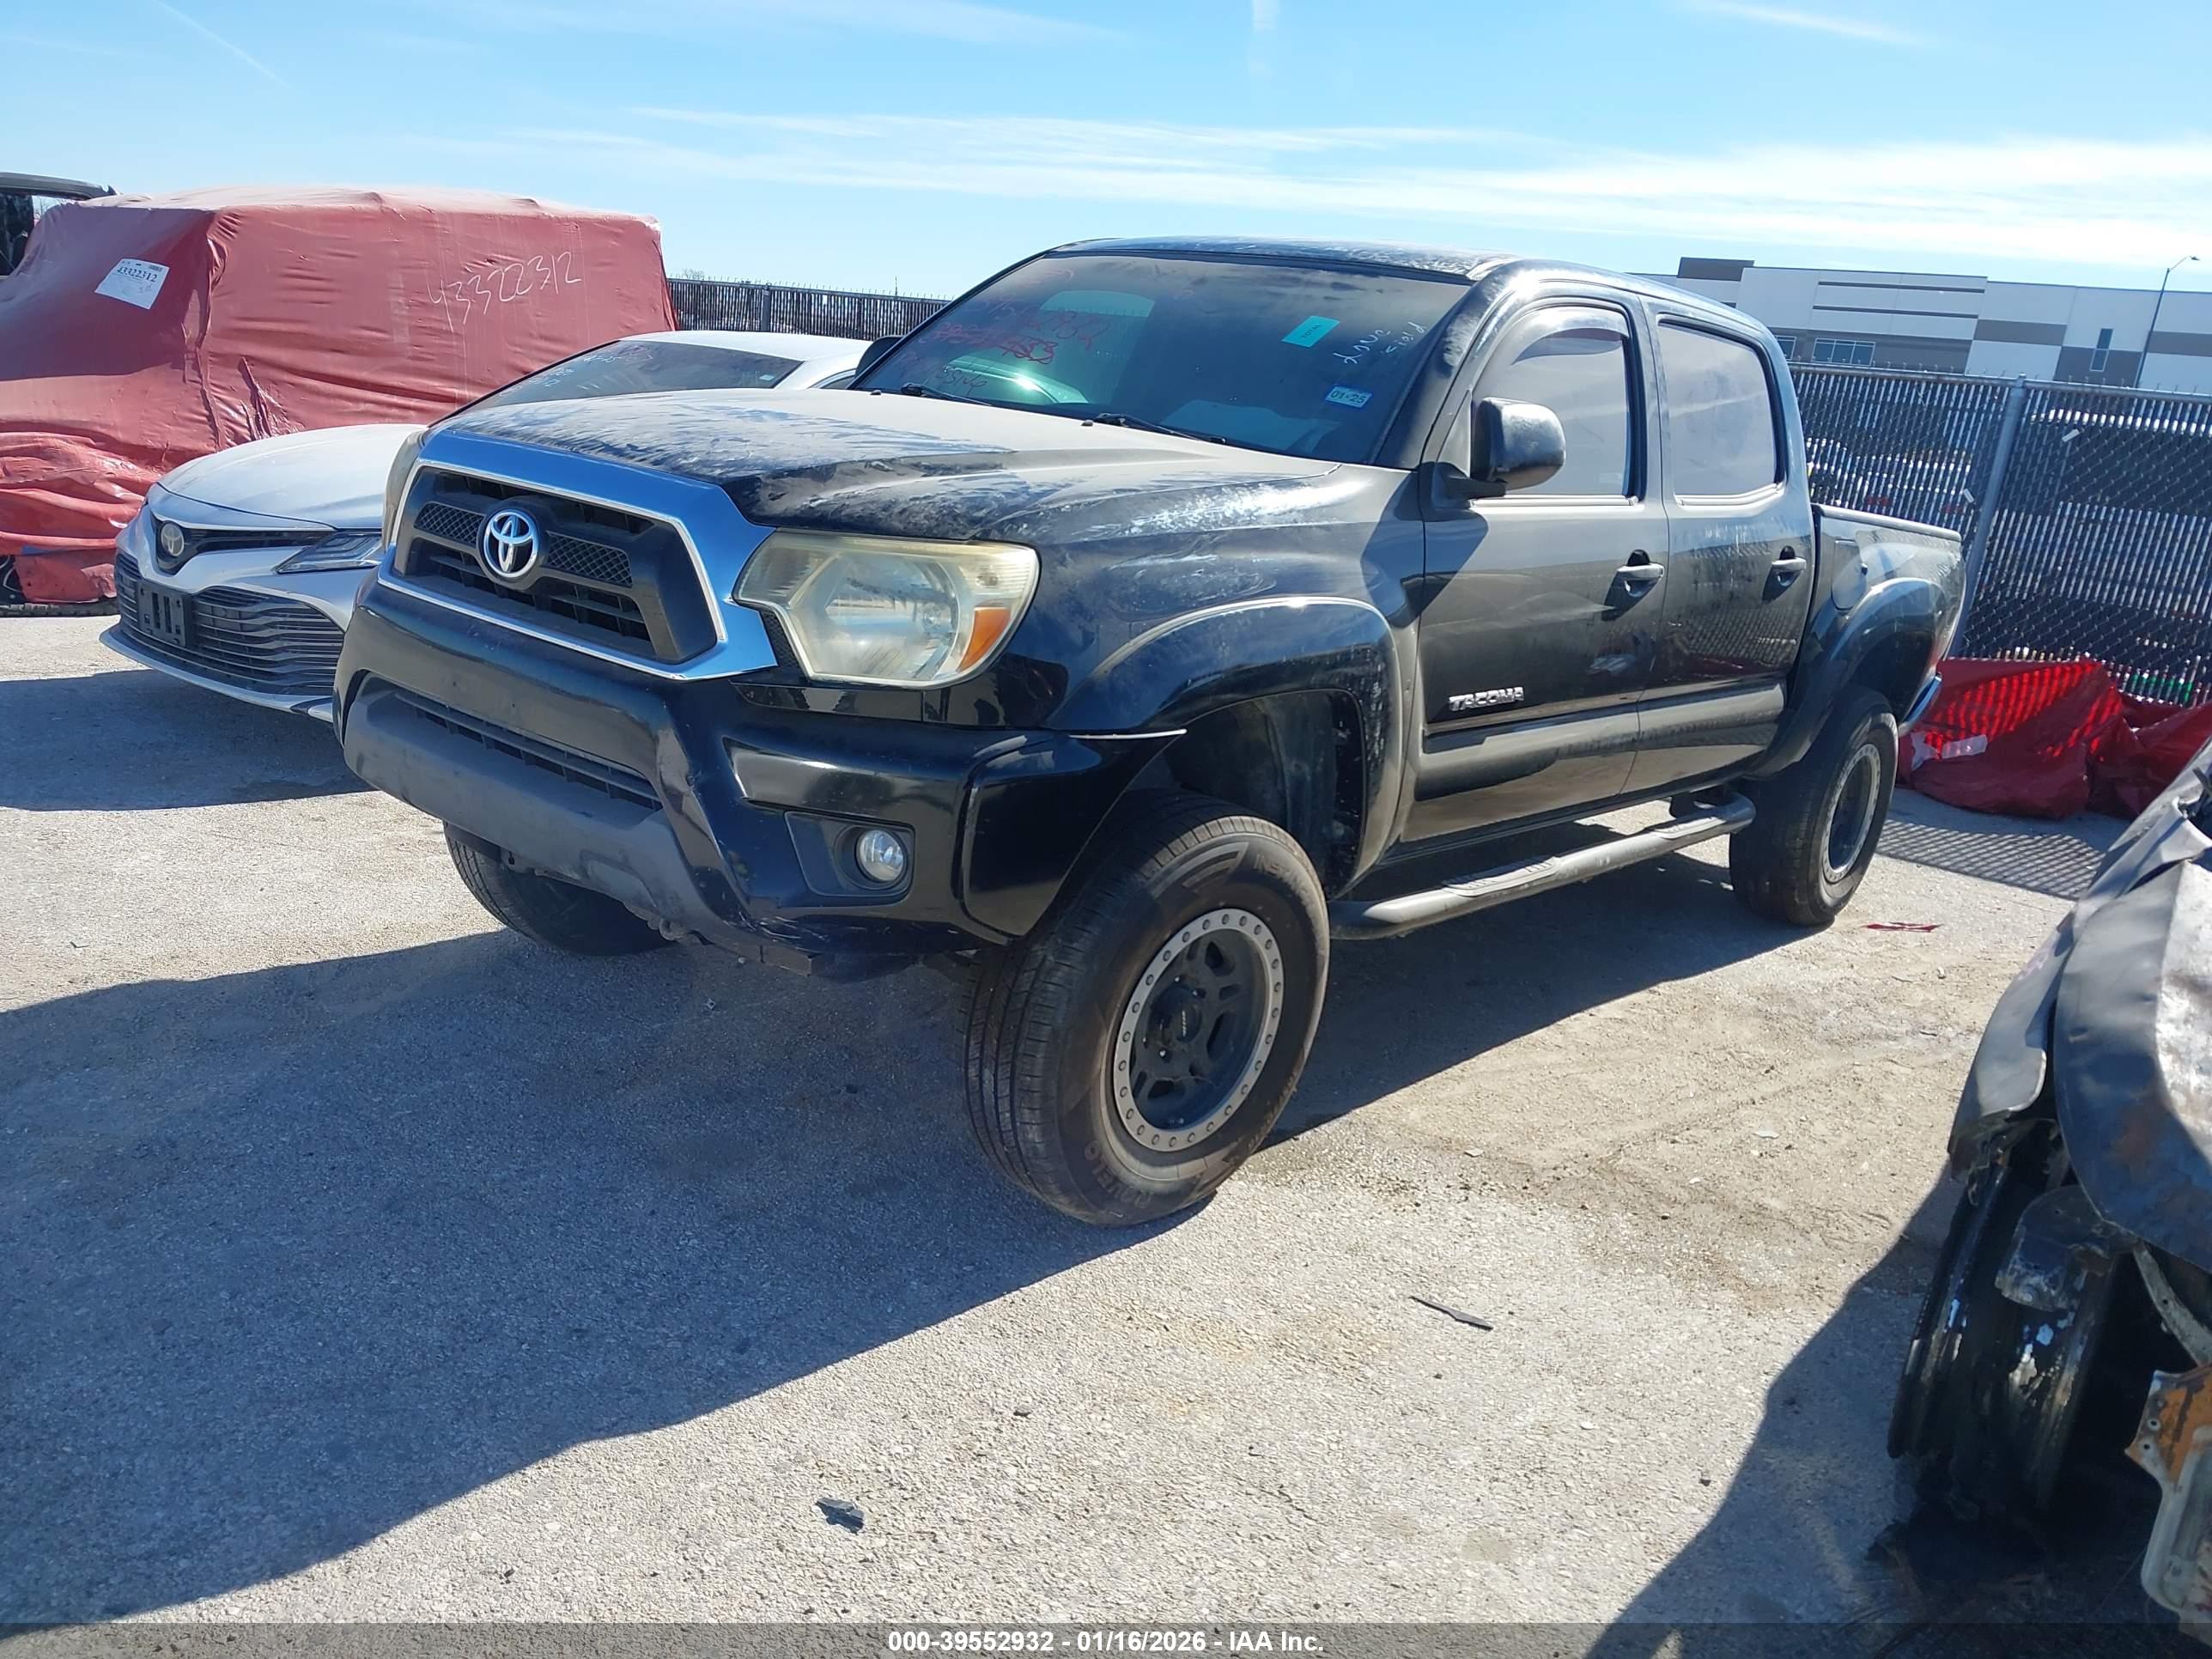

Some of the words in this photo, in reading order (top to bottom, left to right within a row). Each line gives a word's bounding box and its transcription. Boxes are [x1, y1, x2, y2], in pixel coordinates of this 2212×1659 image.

[116, 266, 158, 283] 43322312
[428, 251, 582, 333] 43322312
[1331, 390, 1367, 404] 01-25
[1449, 686, 1524, 712] TACOMA
